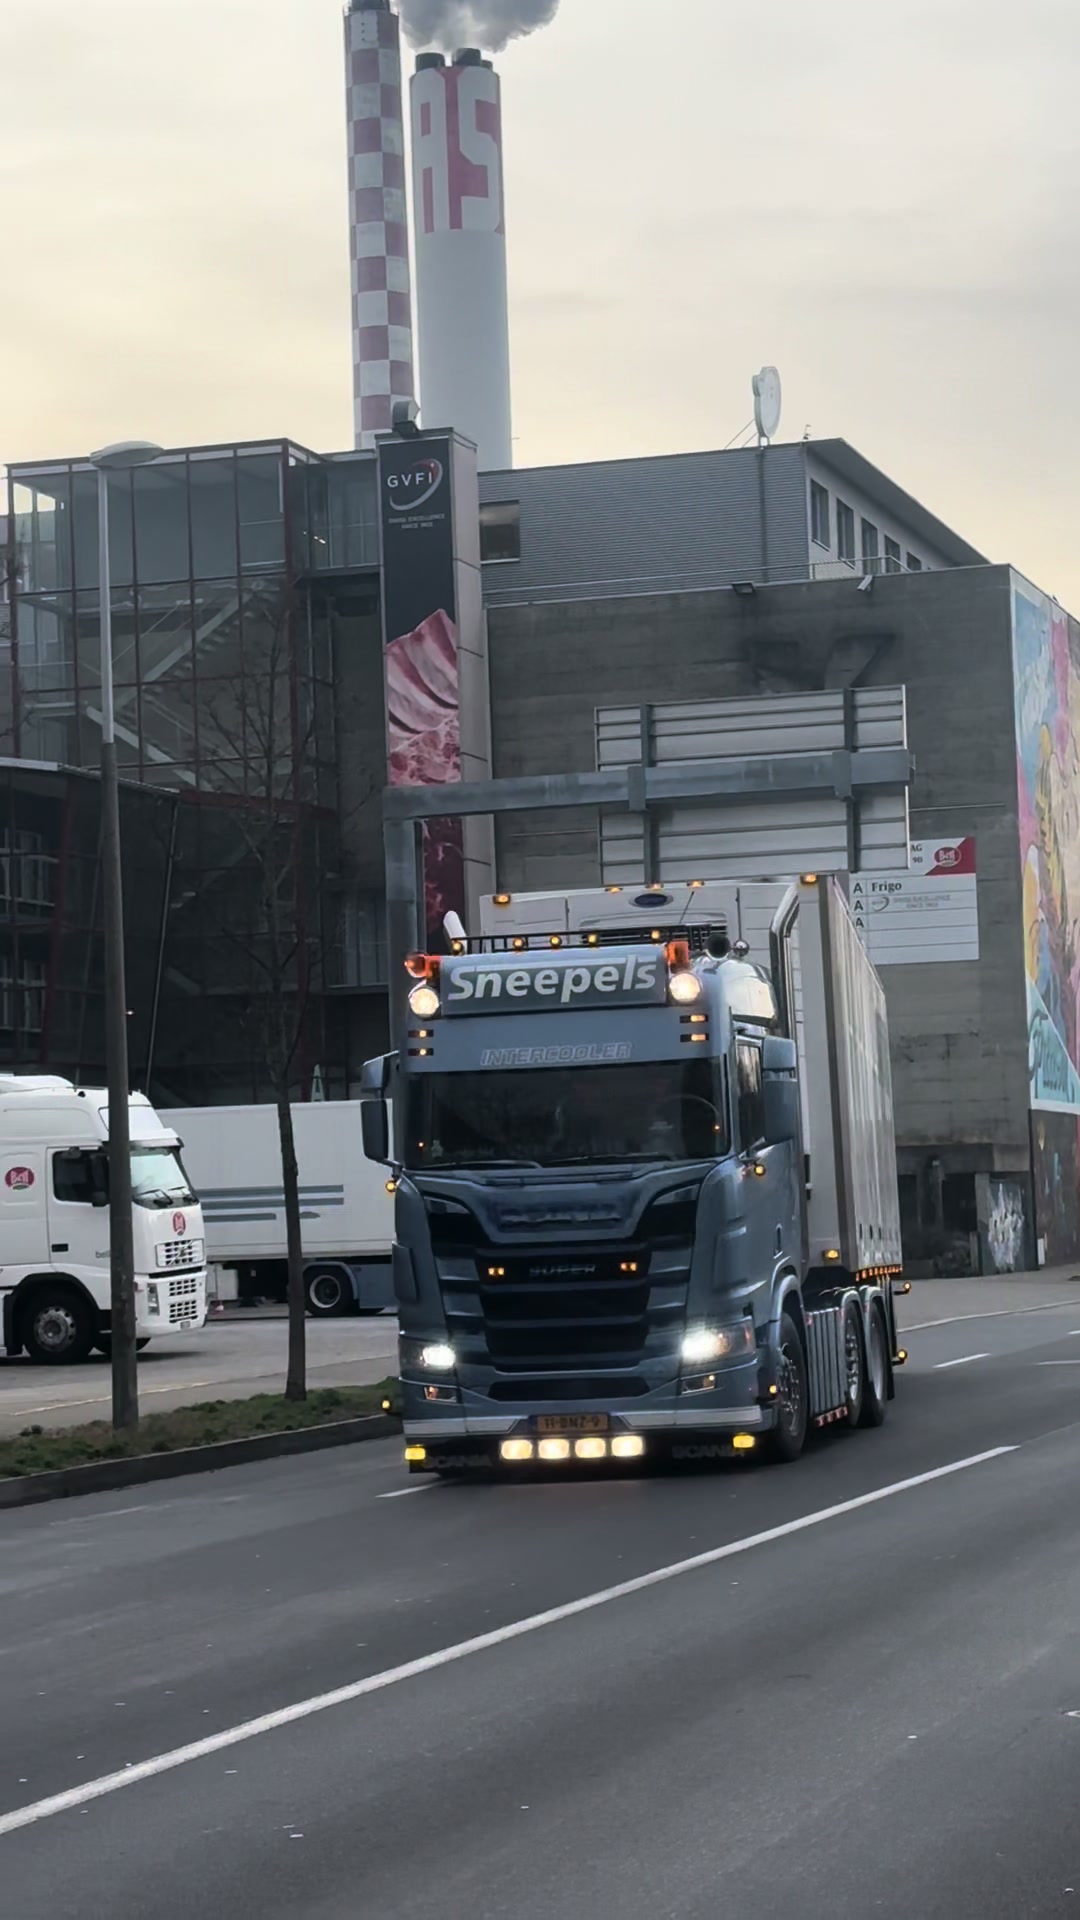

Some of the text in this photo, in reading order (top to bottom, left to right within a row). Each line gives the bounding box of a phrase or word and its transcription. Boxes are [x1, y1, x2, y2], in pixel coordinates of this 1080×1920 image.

[387, 472, 432, 488] GVFI
[853, 881, 902, 895] A Frigo
[854, 900, 864, 911] A
[448, 955, 657, 1003] Sneepels
[480, 1042, 632, 1066] INTERCOOLER
